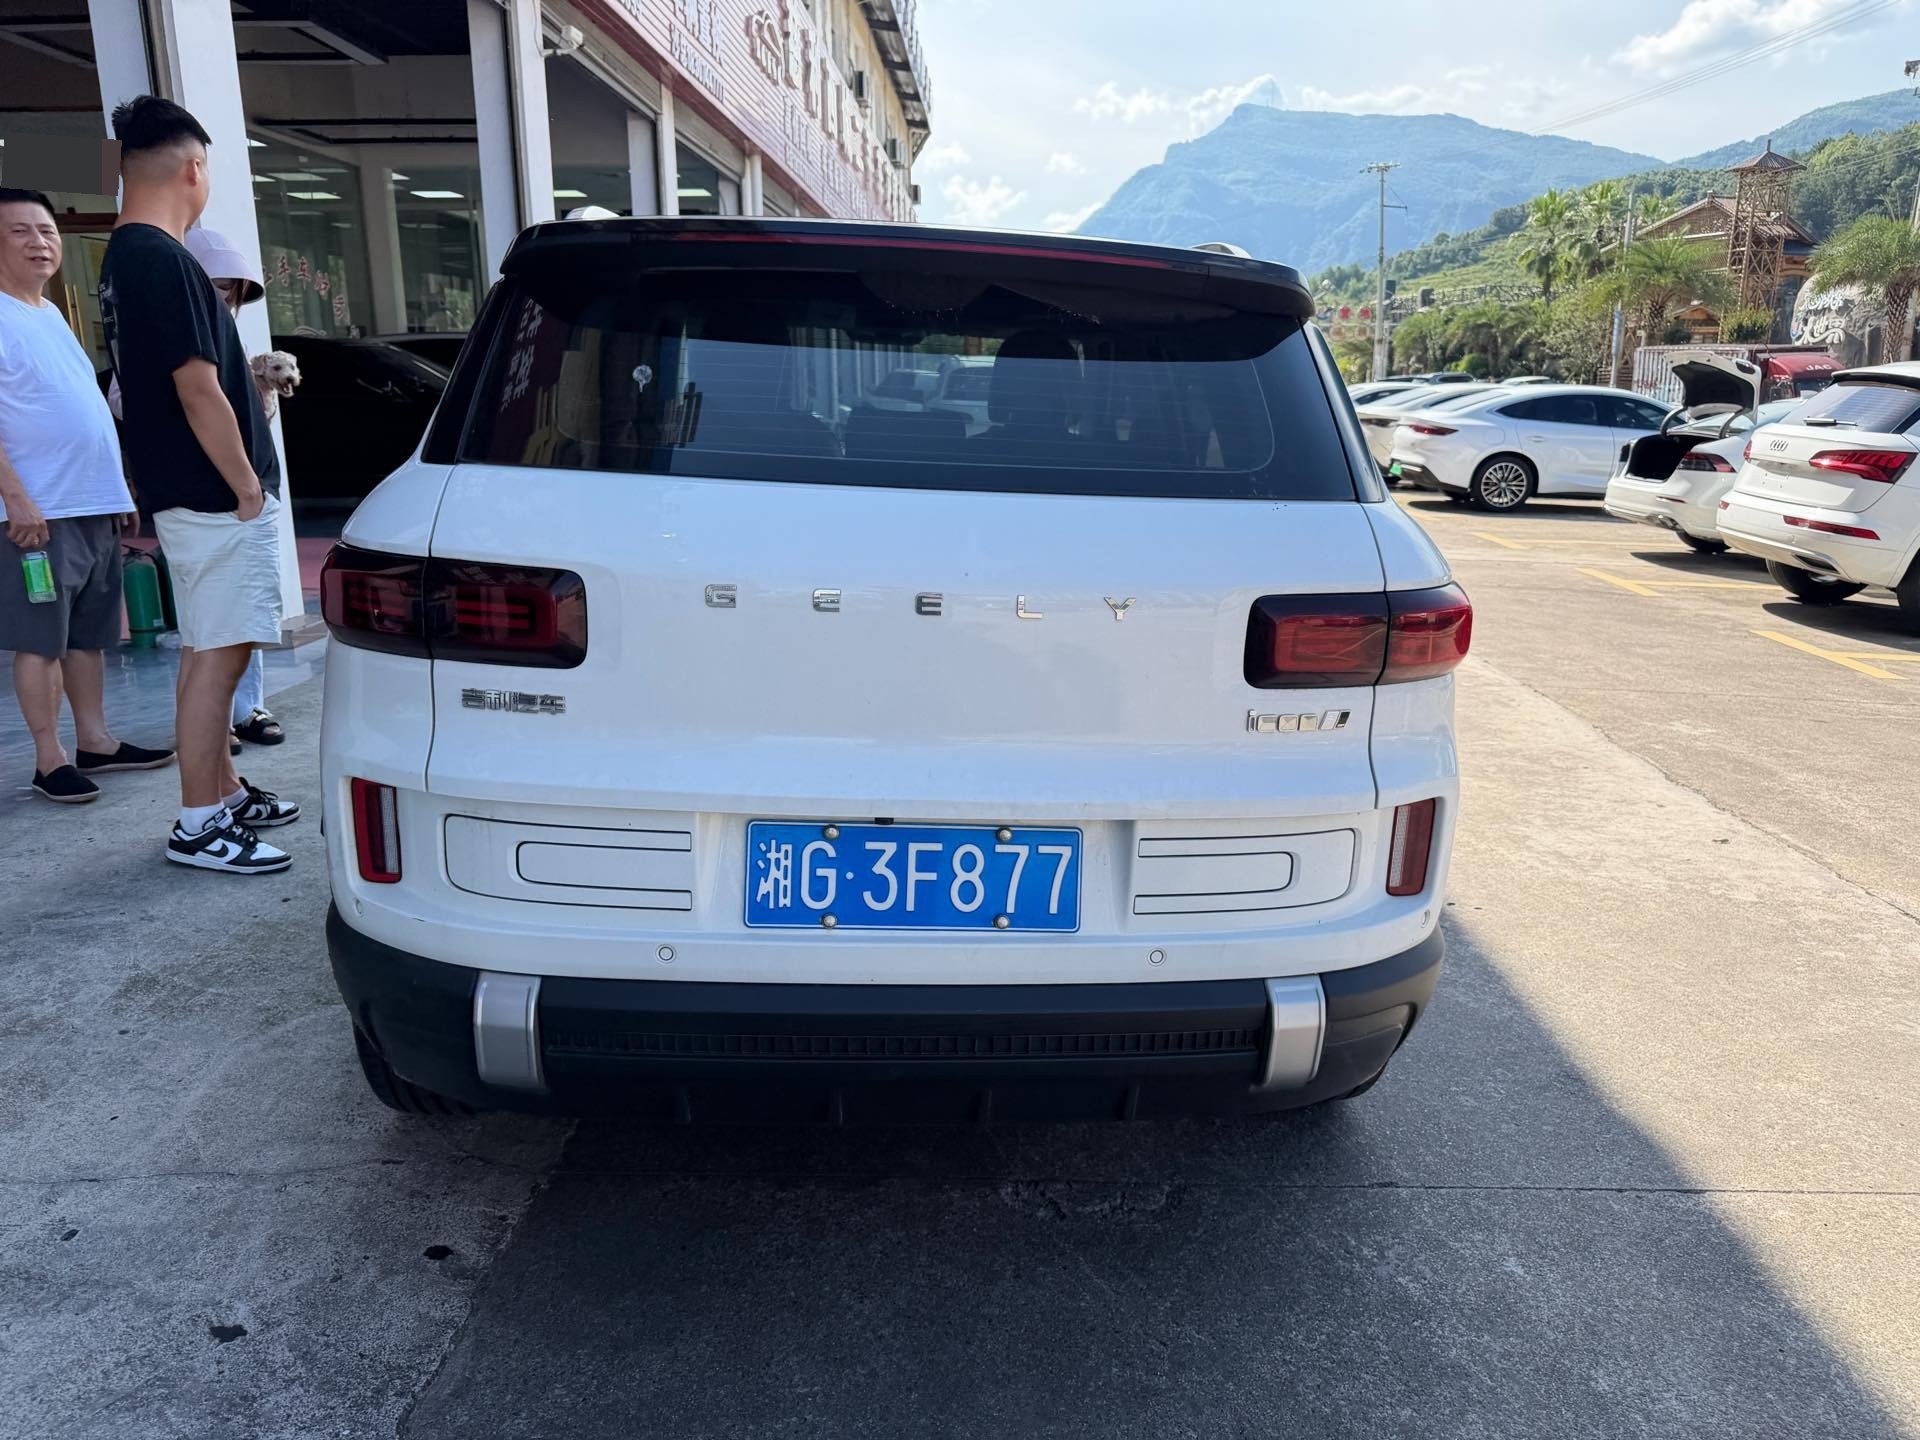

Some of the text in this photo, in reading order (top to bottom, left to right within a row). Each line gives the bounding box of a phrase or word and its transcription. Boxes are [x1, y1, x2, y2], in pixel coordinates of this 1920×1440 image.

[1805, 363, 1832, 371] JAC
[704, 583, 1137, 621] GEELY
[461, 688, 566, 715] 吉利汽车
